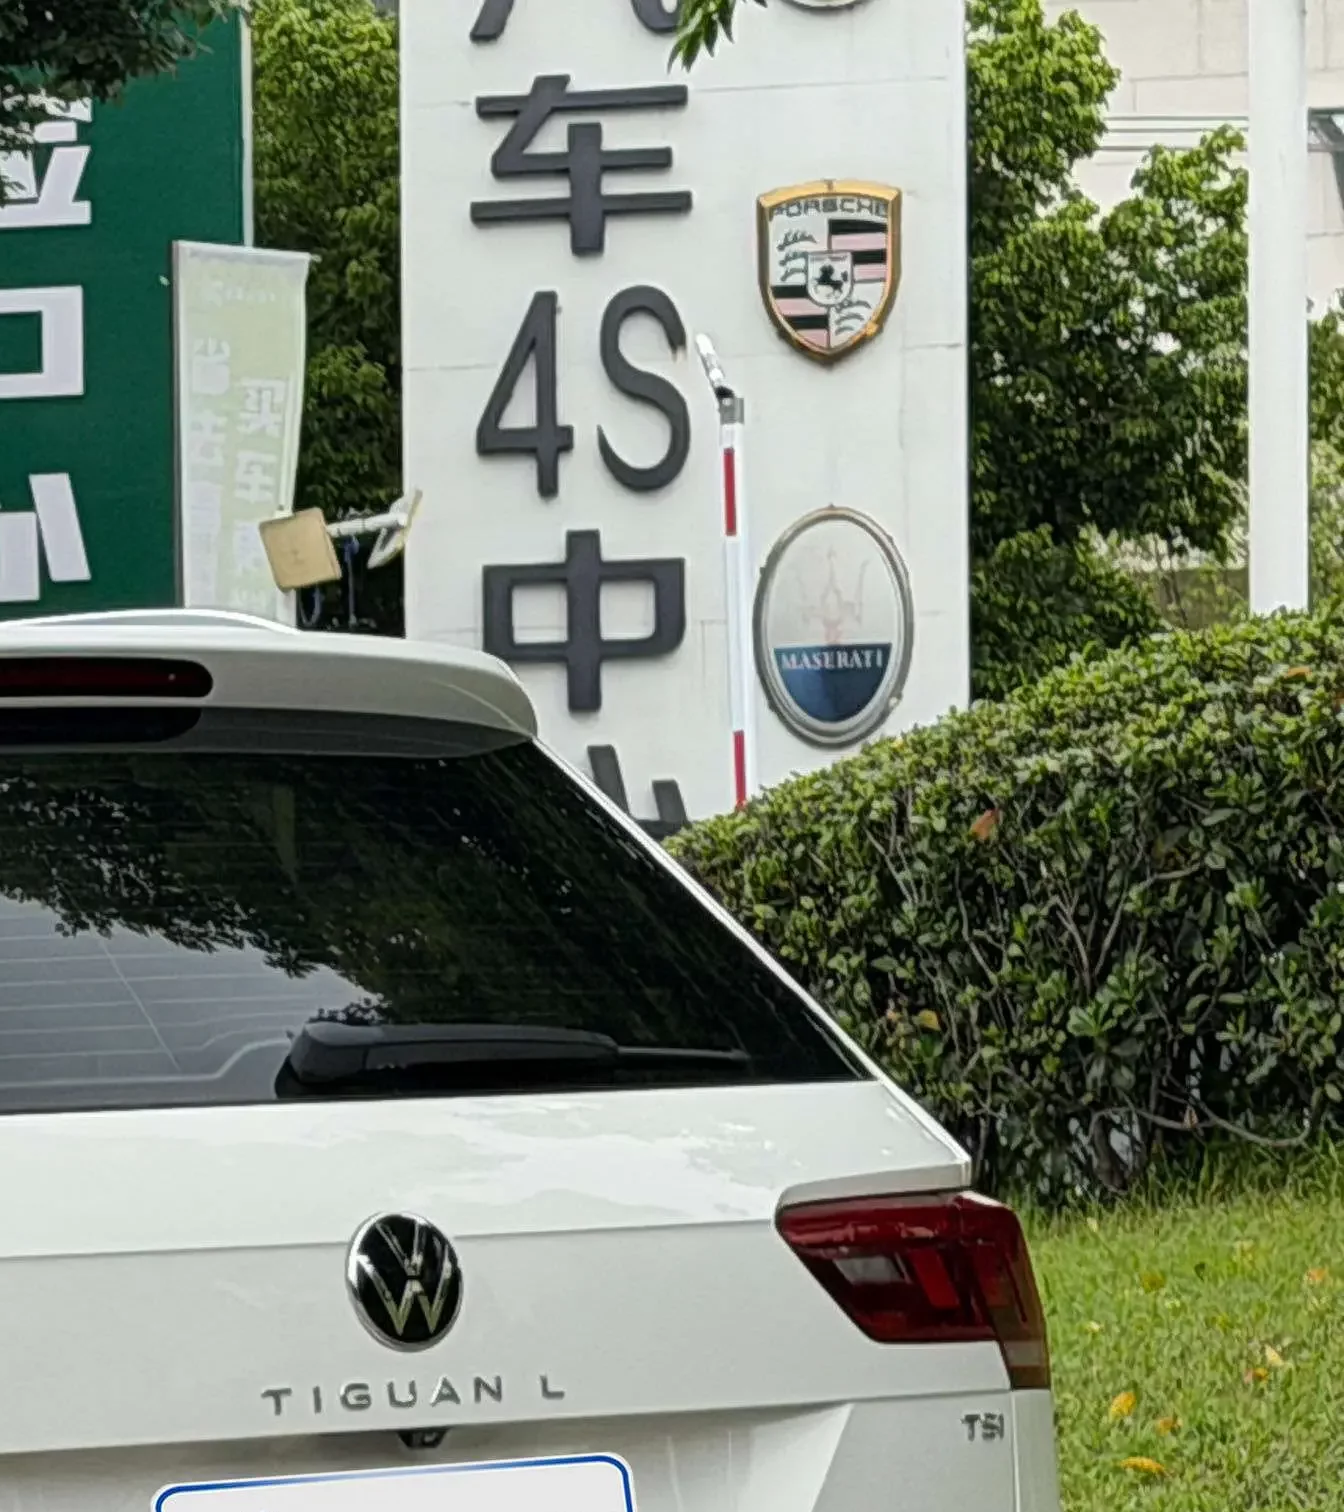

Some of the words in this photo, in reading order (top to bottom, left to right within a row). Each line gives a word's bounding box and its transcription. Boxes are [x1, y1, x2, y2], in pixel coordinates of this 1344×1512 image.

[469, 0, 692, 836] 车4S中
[781, 648, 883, 670] MASERATI
[261, 1374, 503, 1416] TIGUAN
[539, 1373, 566, 1401] L
[960, 1412, 1005, 1442] TSI
